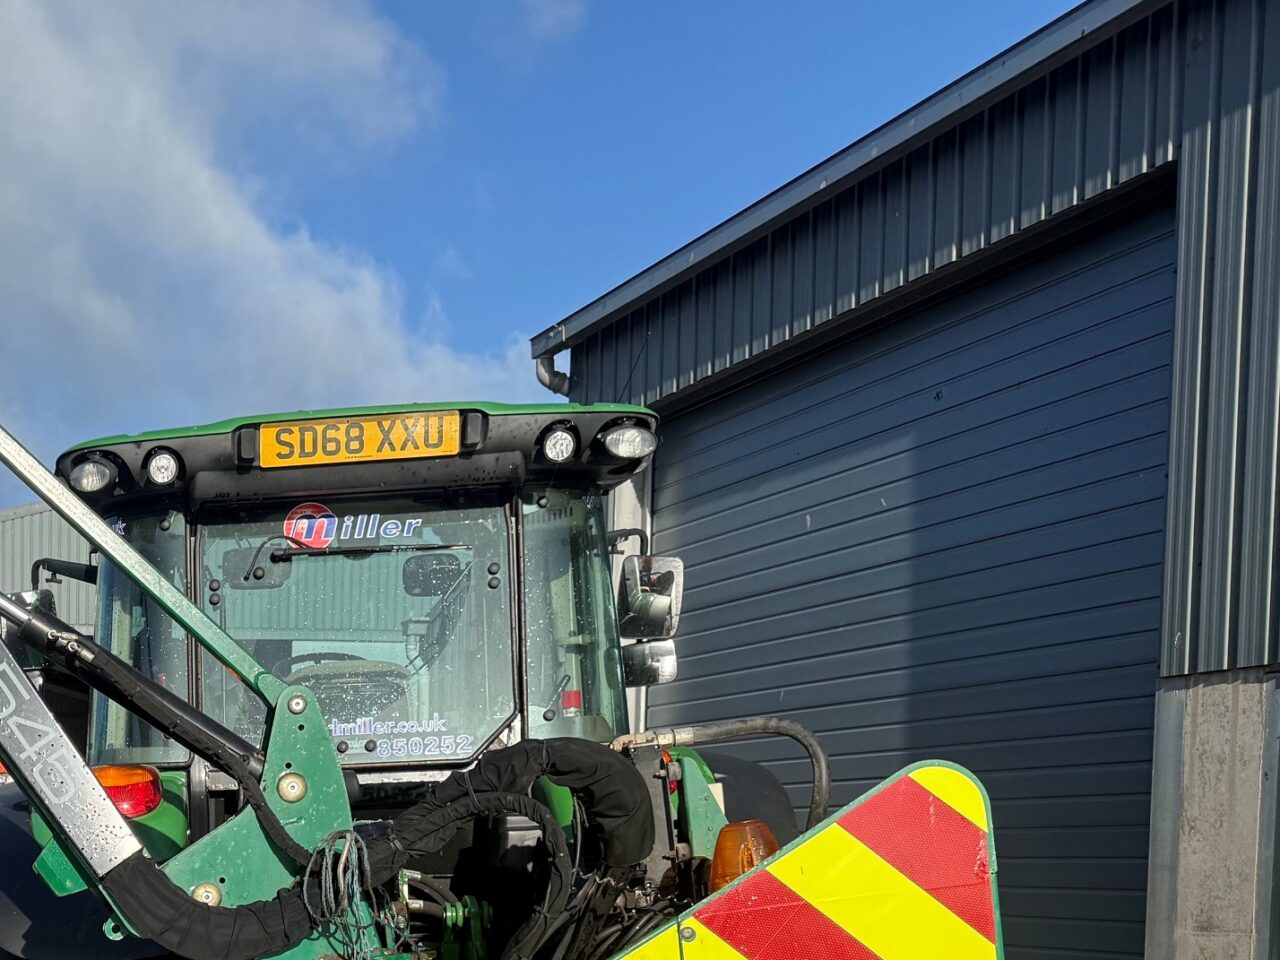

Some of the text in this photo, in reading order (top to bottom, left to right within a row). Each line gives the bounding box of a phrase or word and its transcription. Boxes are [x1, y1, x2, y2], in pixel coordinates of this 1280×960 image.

[275, 416, 444, 460] SD68 XXU
[376, 734, 472, 758] 850252
